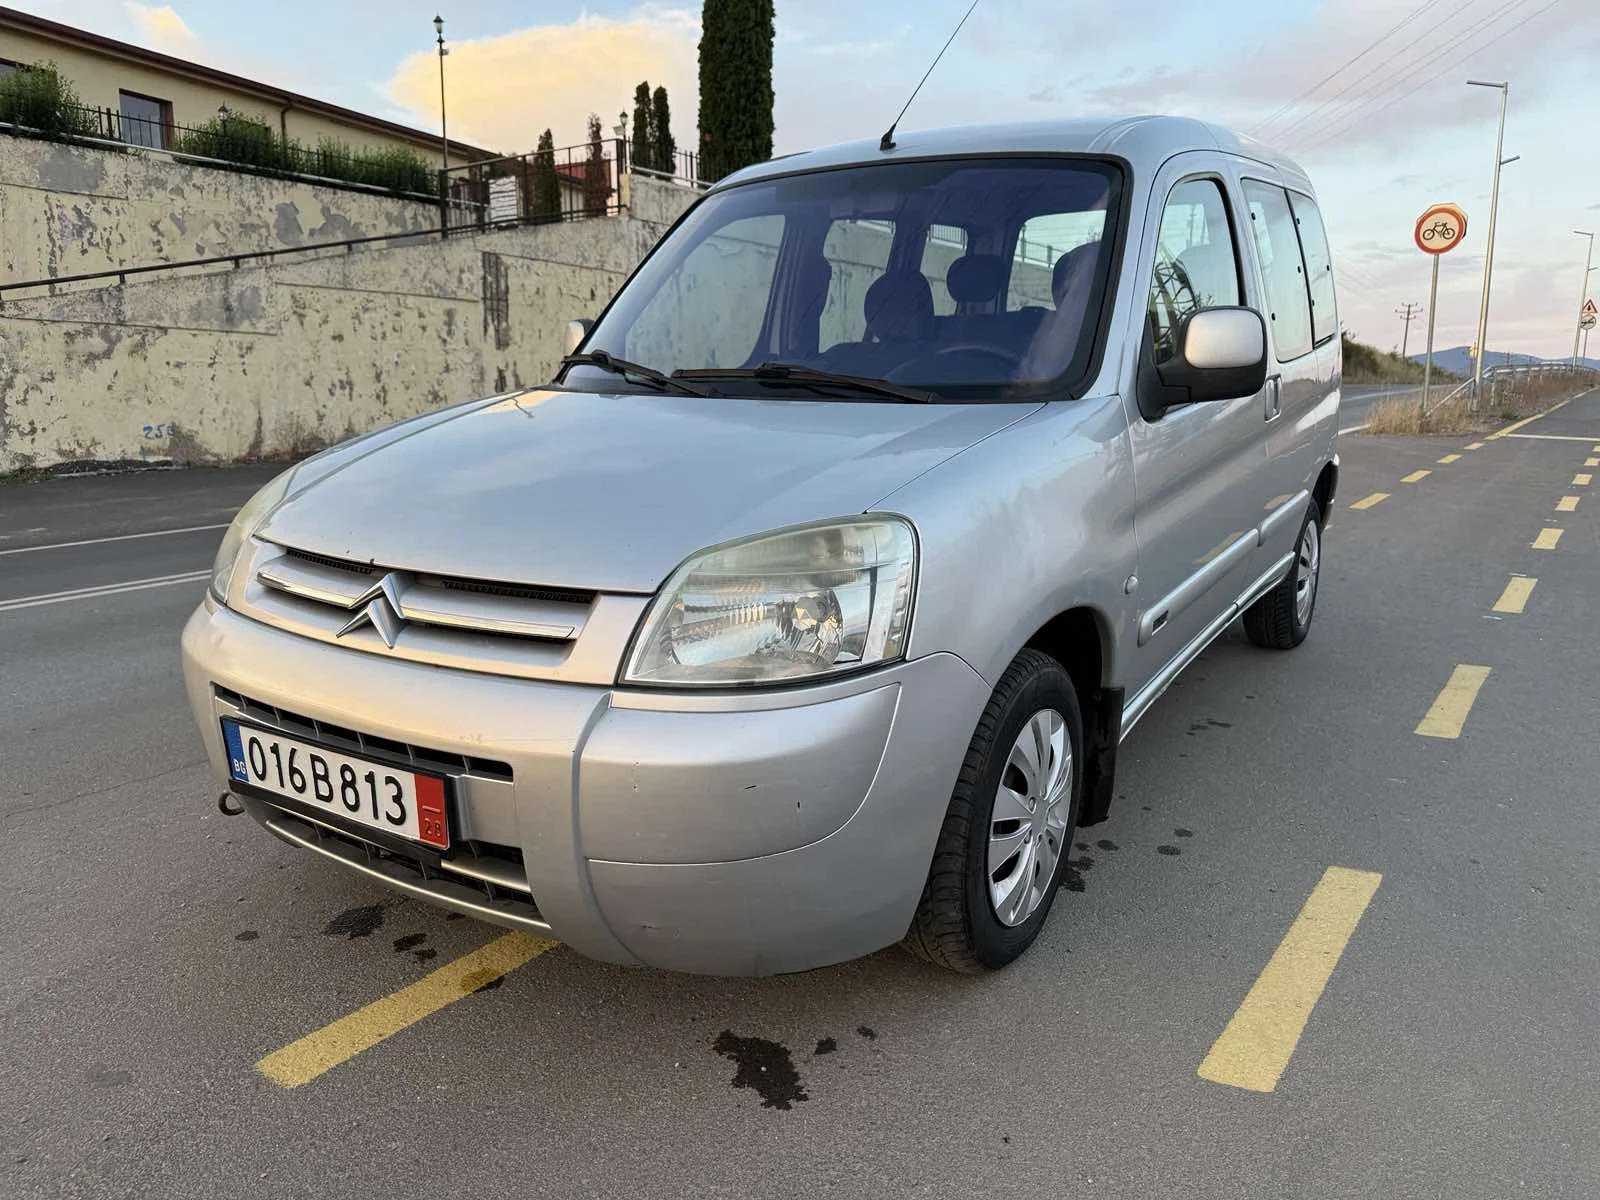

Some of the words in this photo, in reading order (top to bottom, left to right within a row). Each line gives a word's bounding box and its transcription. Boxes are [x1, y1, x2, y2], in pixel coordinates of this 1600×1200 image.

[233, 758, 246, 775] BG
[248, 736, 407, 826] 016B813
[424, 817, 441, 838] 28
